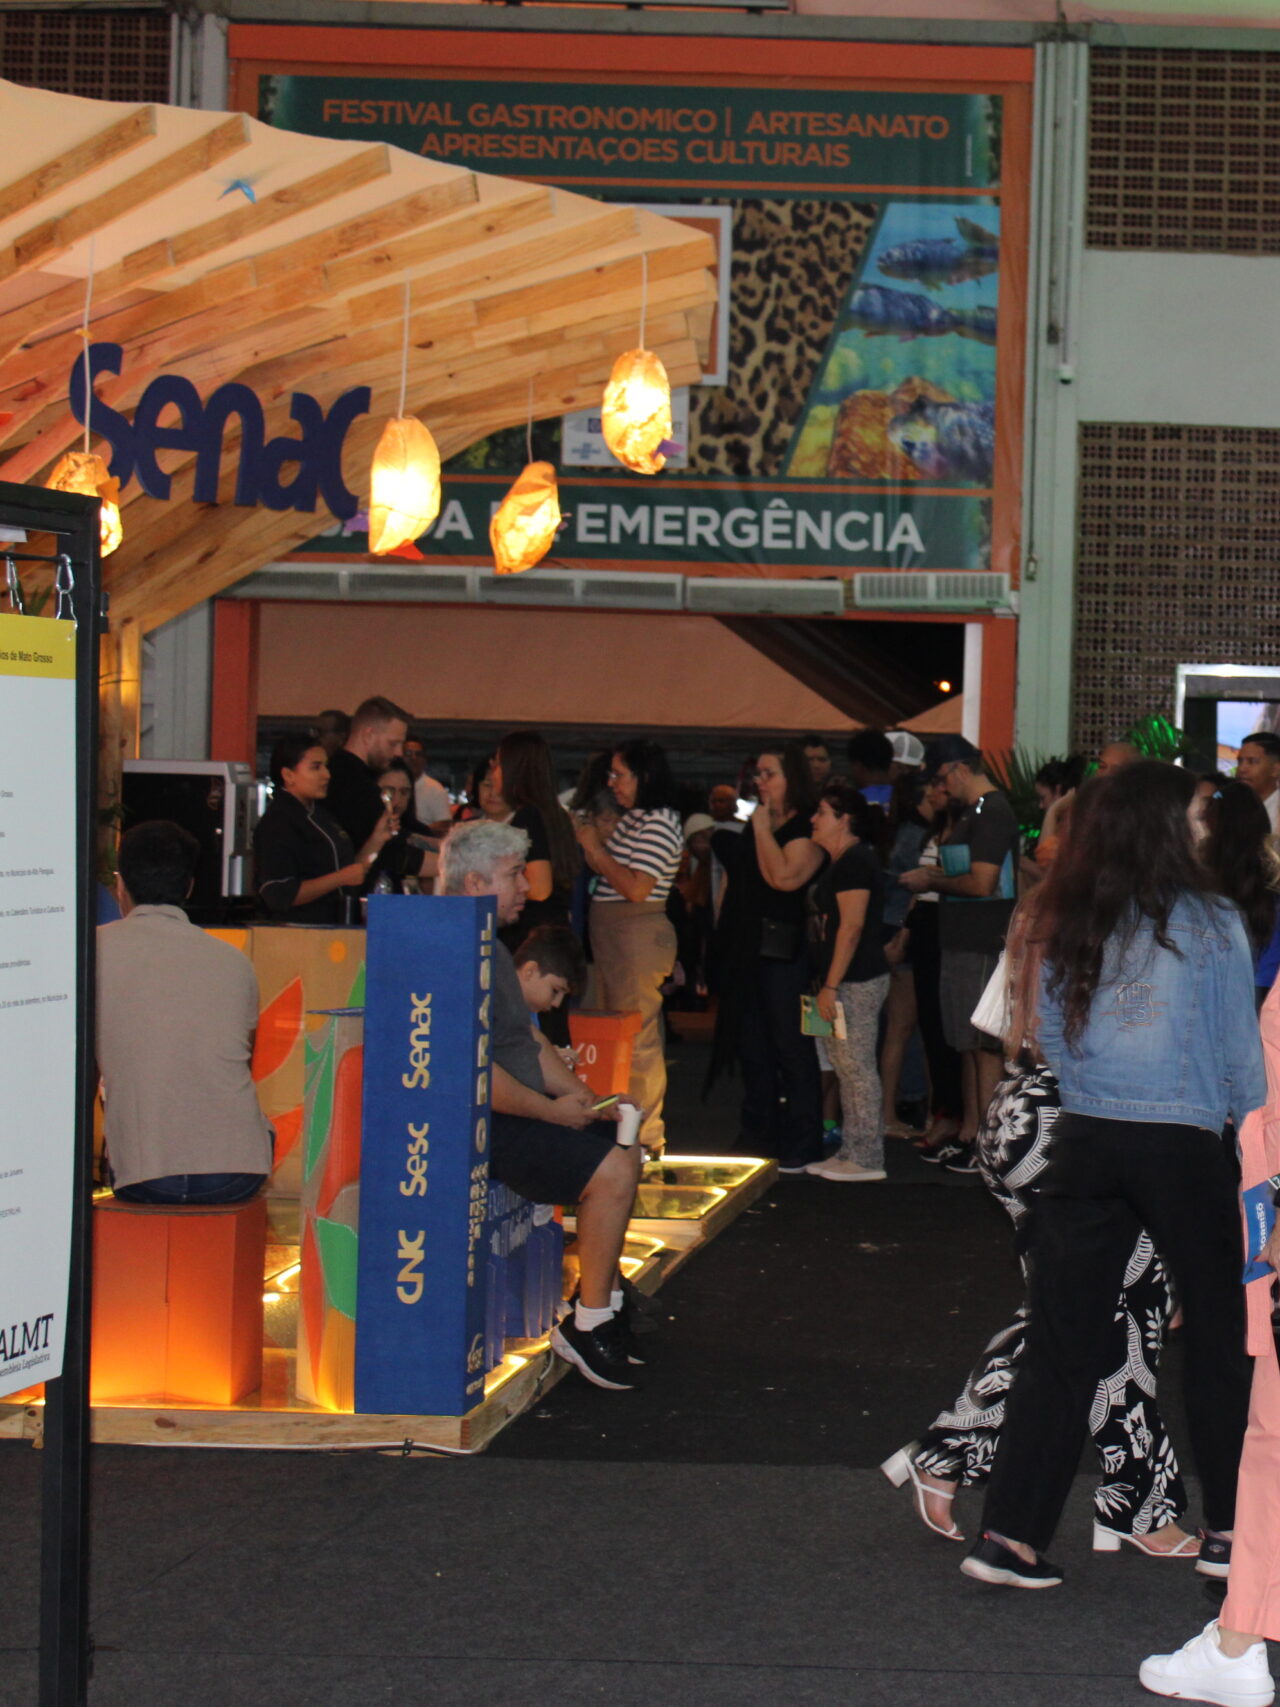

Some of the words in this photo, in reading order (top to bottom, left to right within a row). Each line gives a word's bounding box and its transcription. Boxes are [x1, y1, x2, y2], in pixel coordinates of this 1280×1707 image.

[322, 99, 461, 127] FESTIVAL
[745, 111, 949, 139] ARTESANATO
[685, 139, 851, 167] CULTURAIS
[69, 342, 371, 521] Senac
[576, 498, 925, 553] EMERGÊNCIA
[402, 993, 432, 1089] Senac
[477, 912, 493, 1106] BRASIL
[400, 1123, 429, 1196] Sesc
[0, 1313, 54, 1362] ALMT
